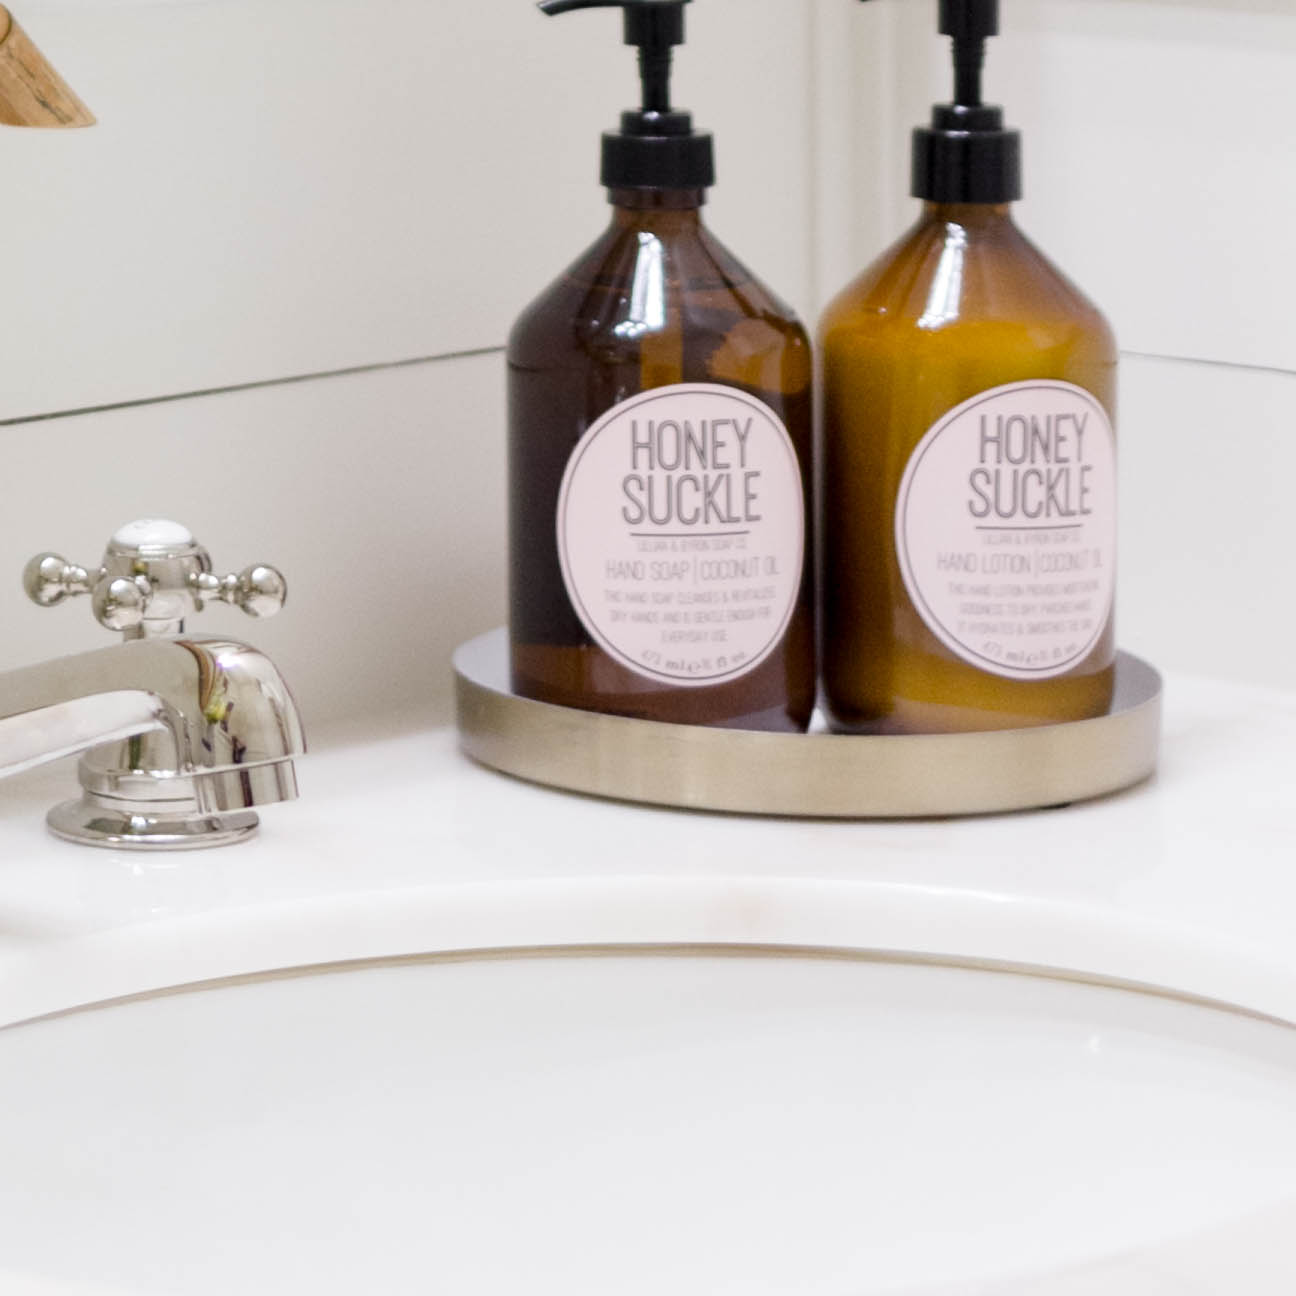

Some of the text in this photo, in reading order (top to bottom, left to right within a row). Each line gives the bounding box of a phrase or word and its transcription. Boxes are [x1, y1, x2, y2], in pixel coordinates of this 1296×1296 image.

[631, 417, 753, 470] HONEY
[978, 412, 1089, 465] HONEY
[621, 471, 762, 526] SUCKLE
[967, 465, 1094, 519] SUCKLE
[605, 559, 645, 581] HAND
[650, 560, 690, 582] SOAP
[700, 556, 760, 581] COCONUT
[937, 552, 977, 574] HAND
[982, 553, 1031, 575] LOTION
